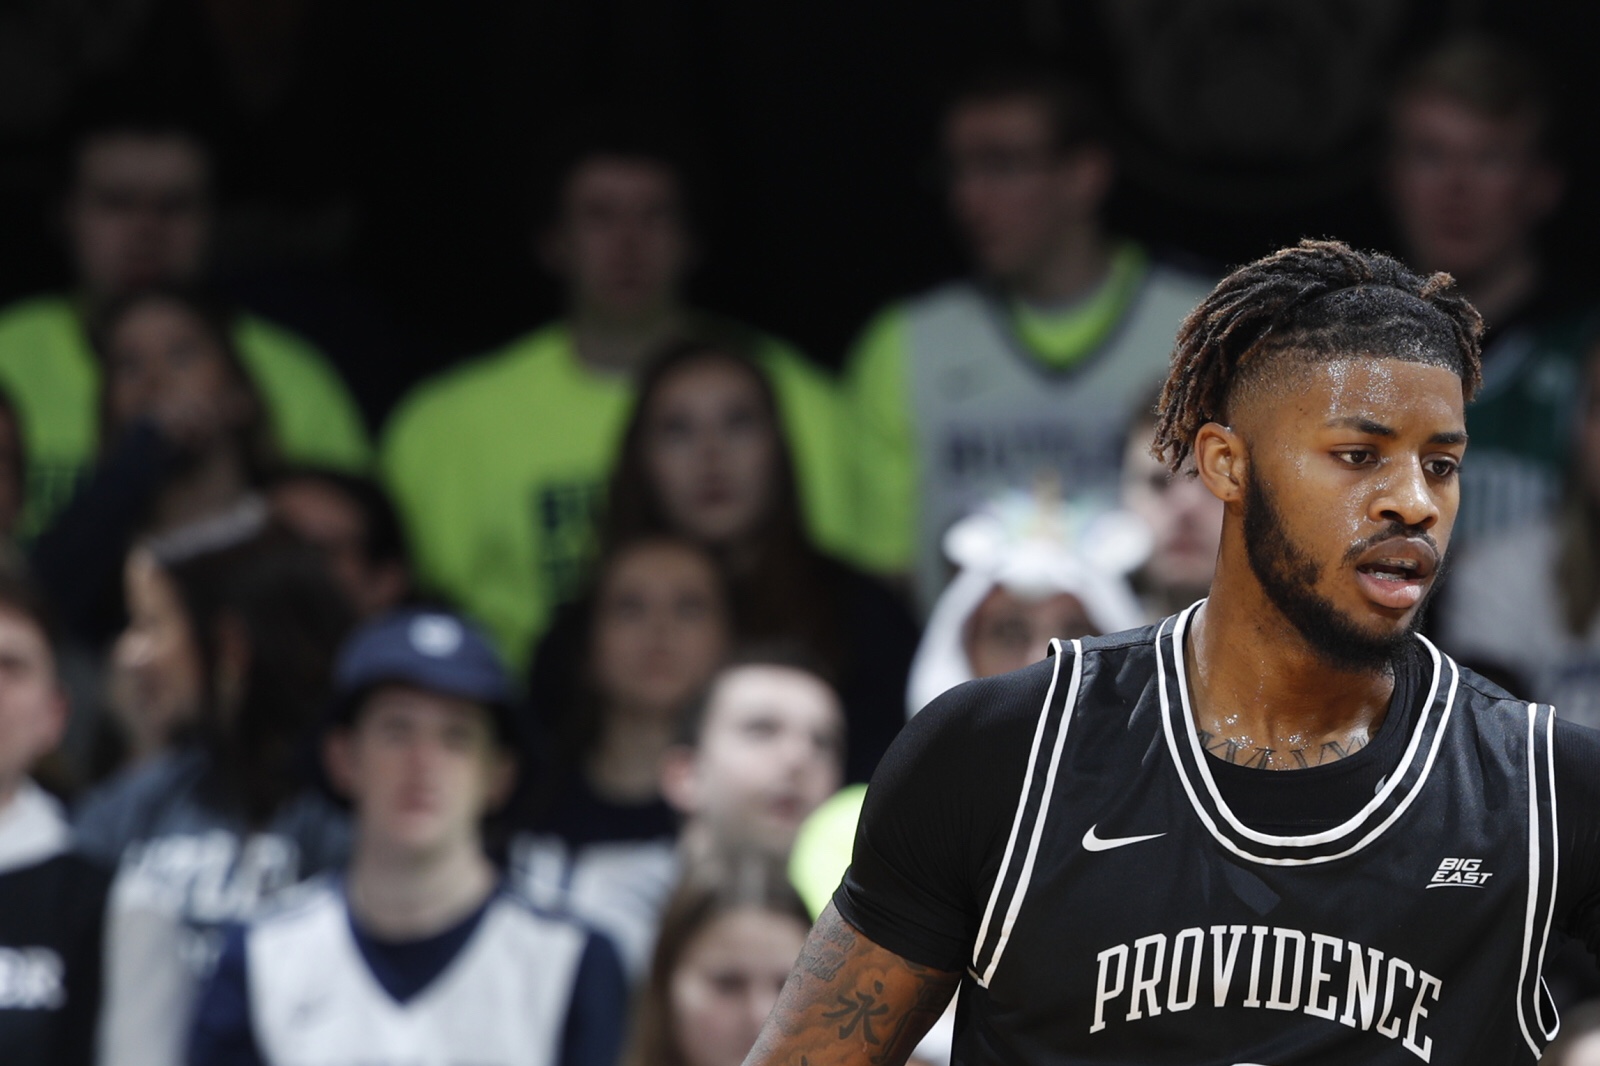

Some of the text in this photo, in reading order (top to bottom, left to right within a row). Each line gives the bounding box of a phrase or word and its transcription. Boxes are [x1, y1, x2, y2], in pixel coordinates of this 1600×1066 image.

[1437, 857, 1484, 872] BIG
[1430, 870, 1494, 885] EAST
[1089, 924, 1443, 1064] PROVIDENCE
